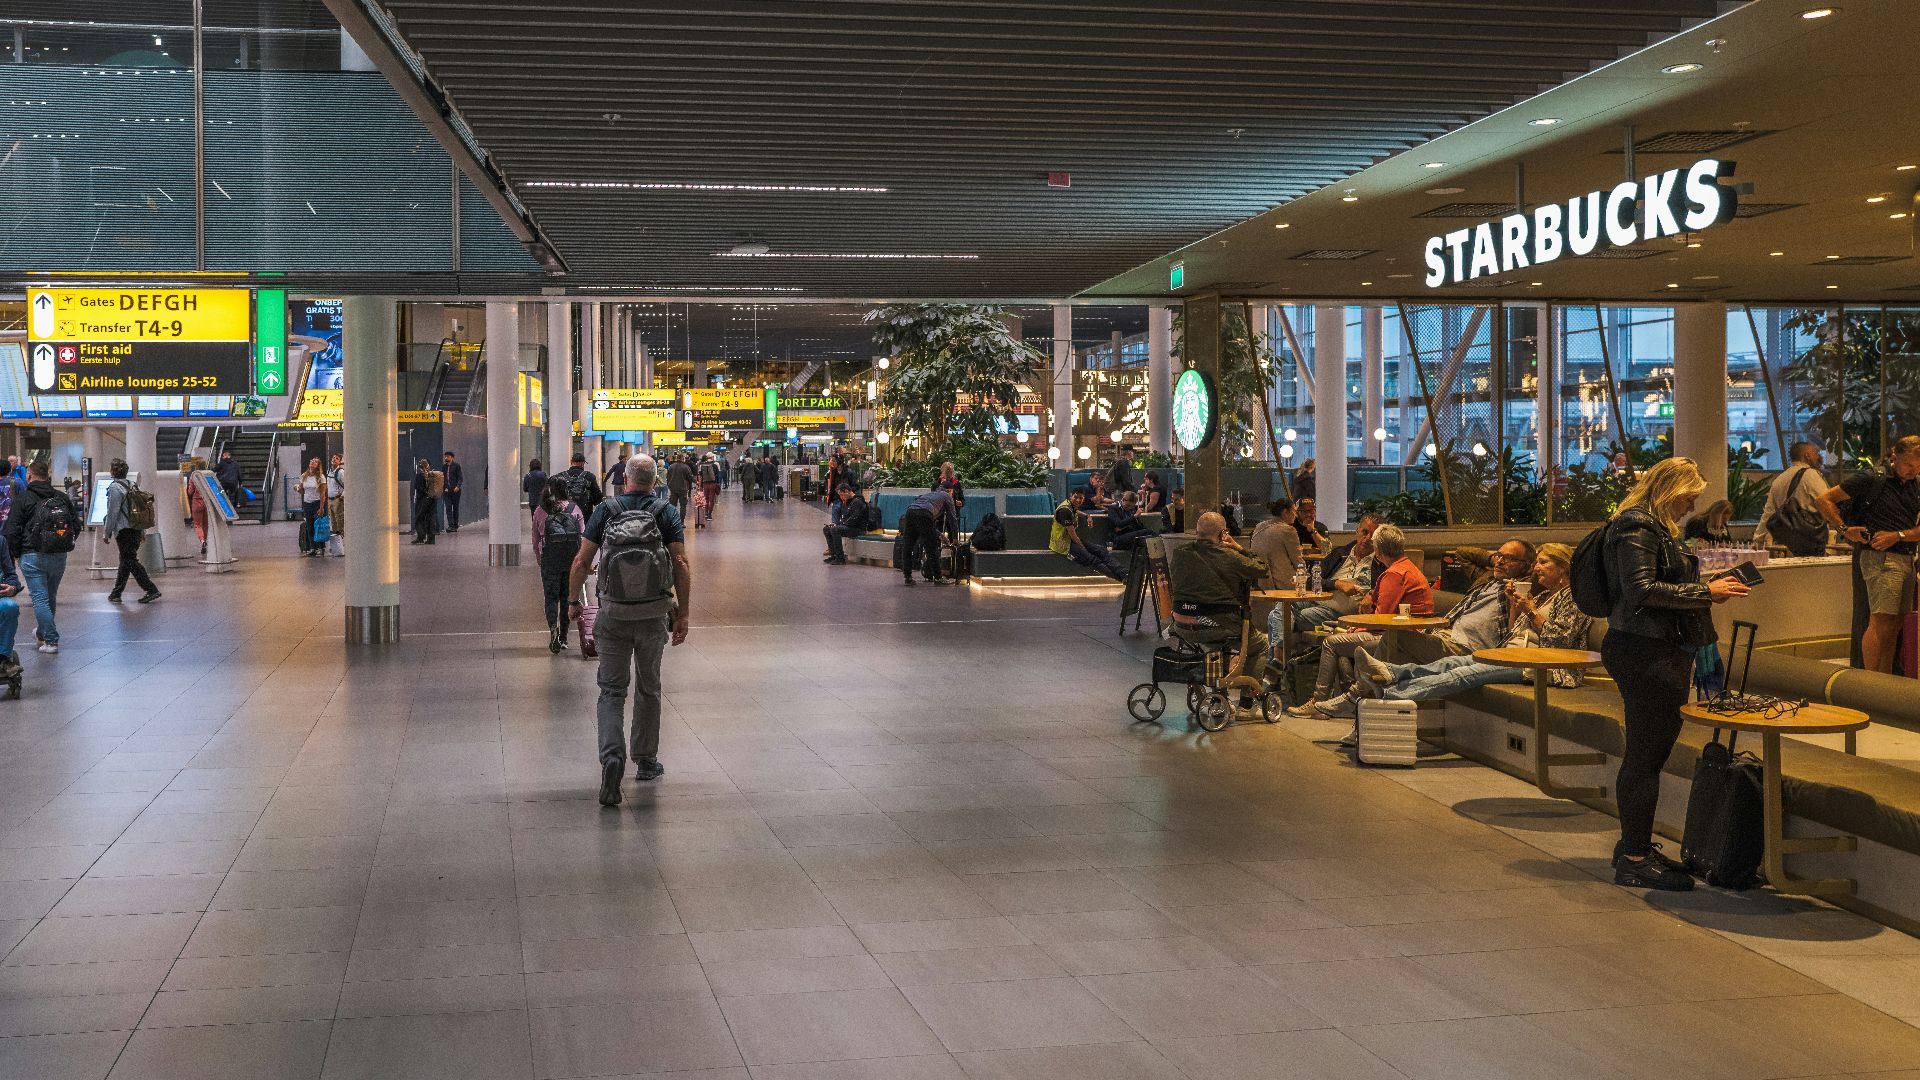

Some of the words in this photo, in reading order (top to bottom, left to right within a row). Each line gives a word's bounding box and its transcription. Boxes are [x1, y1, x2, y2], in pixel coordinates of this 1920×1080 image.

[1424, 158, 1721, 288] STARBUCKS
[80, 297, 115, 307] Gates
[119, 294, 197, 311] DEFGH
[305, 306, 335, 314] GRATIS
[80, 322, 132, 333] Transfer
[134, 320, 183, 337] T4-9
[80, 343, 109, 355] First
[112, 343, 132, 355] aid
[80, 356, 103, 364] Eerste
[103, 356, 121, 366] hulp
[80, 376, 124, 387] Airline
[128, 376, 179, 390] lounges
[182, 376, 217, 387] 25-52
[720, 400, 739, 408] T4-9
[777, 397, 807, 408] PORT
[810, 397, 841, 408] PARK
